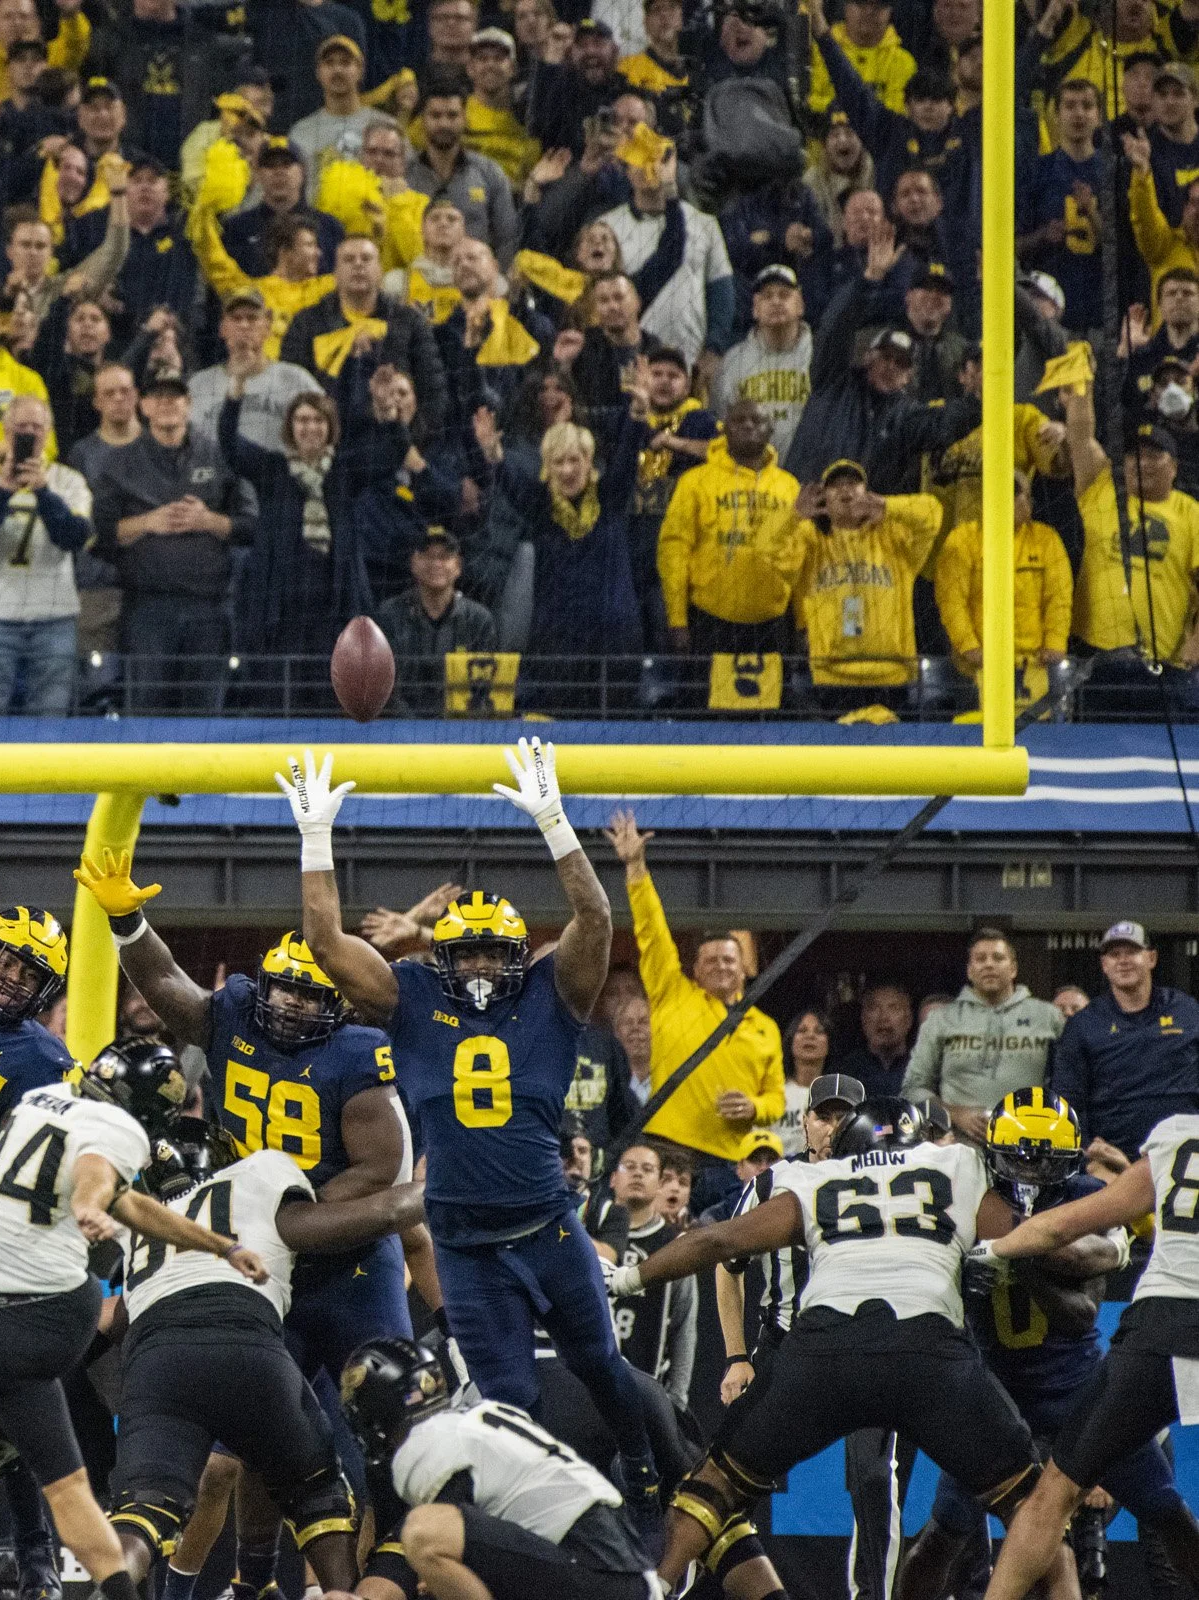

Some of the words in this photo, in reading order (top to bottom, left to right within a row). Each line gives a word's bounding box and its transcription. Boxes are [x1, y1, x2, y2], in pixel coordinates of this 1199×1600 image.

[453, 1034, 513, 1128] 8
[939, 1035, 1048, 1051] MICHIGAN
[224, 1059, 321, 1170] 58
[814, 1168, 957, 1246] 63
